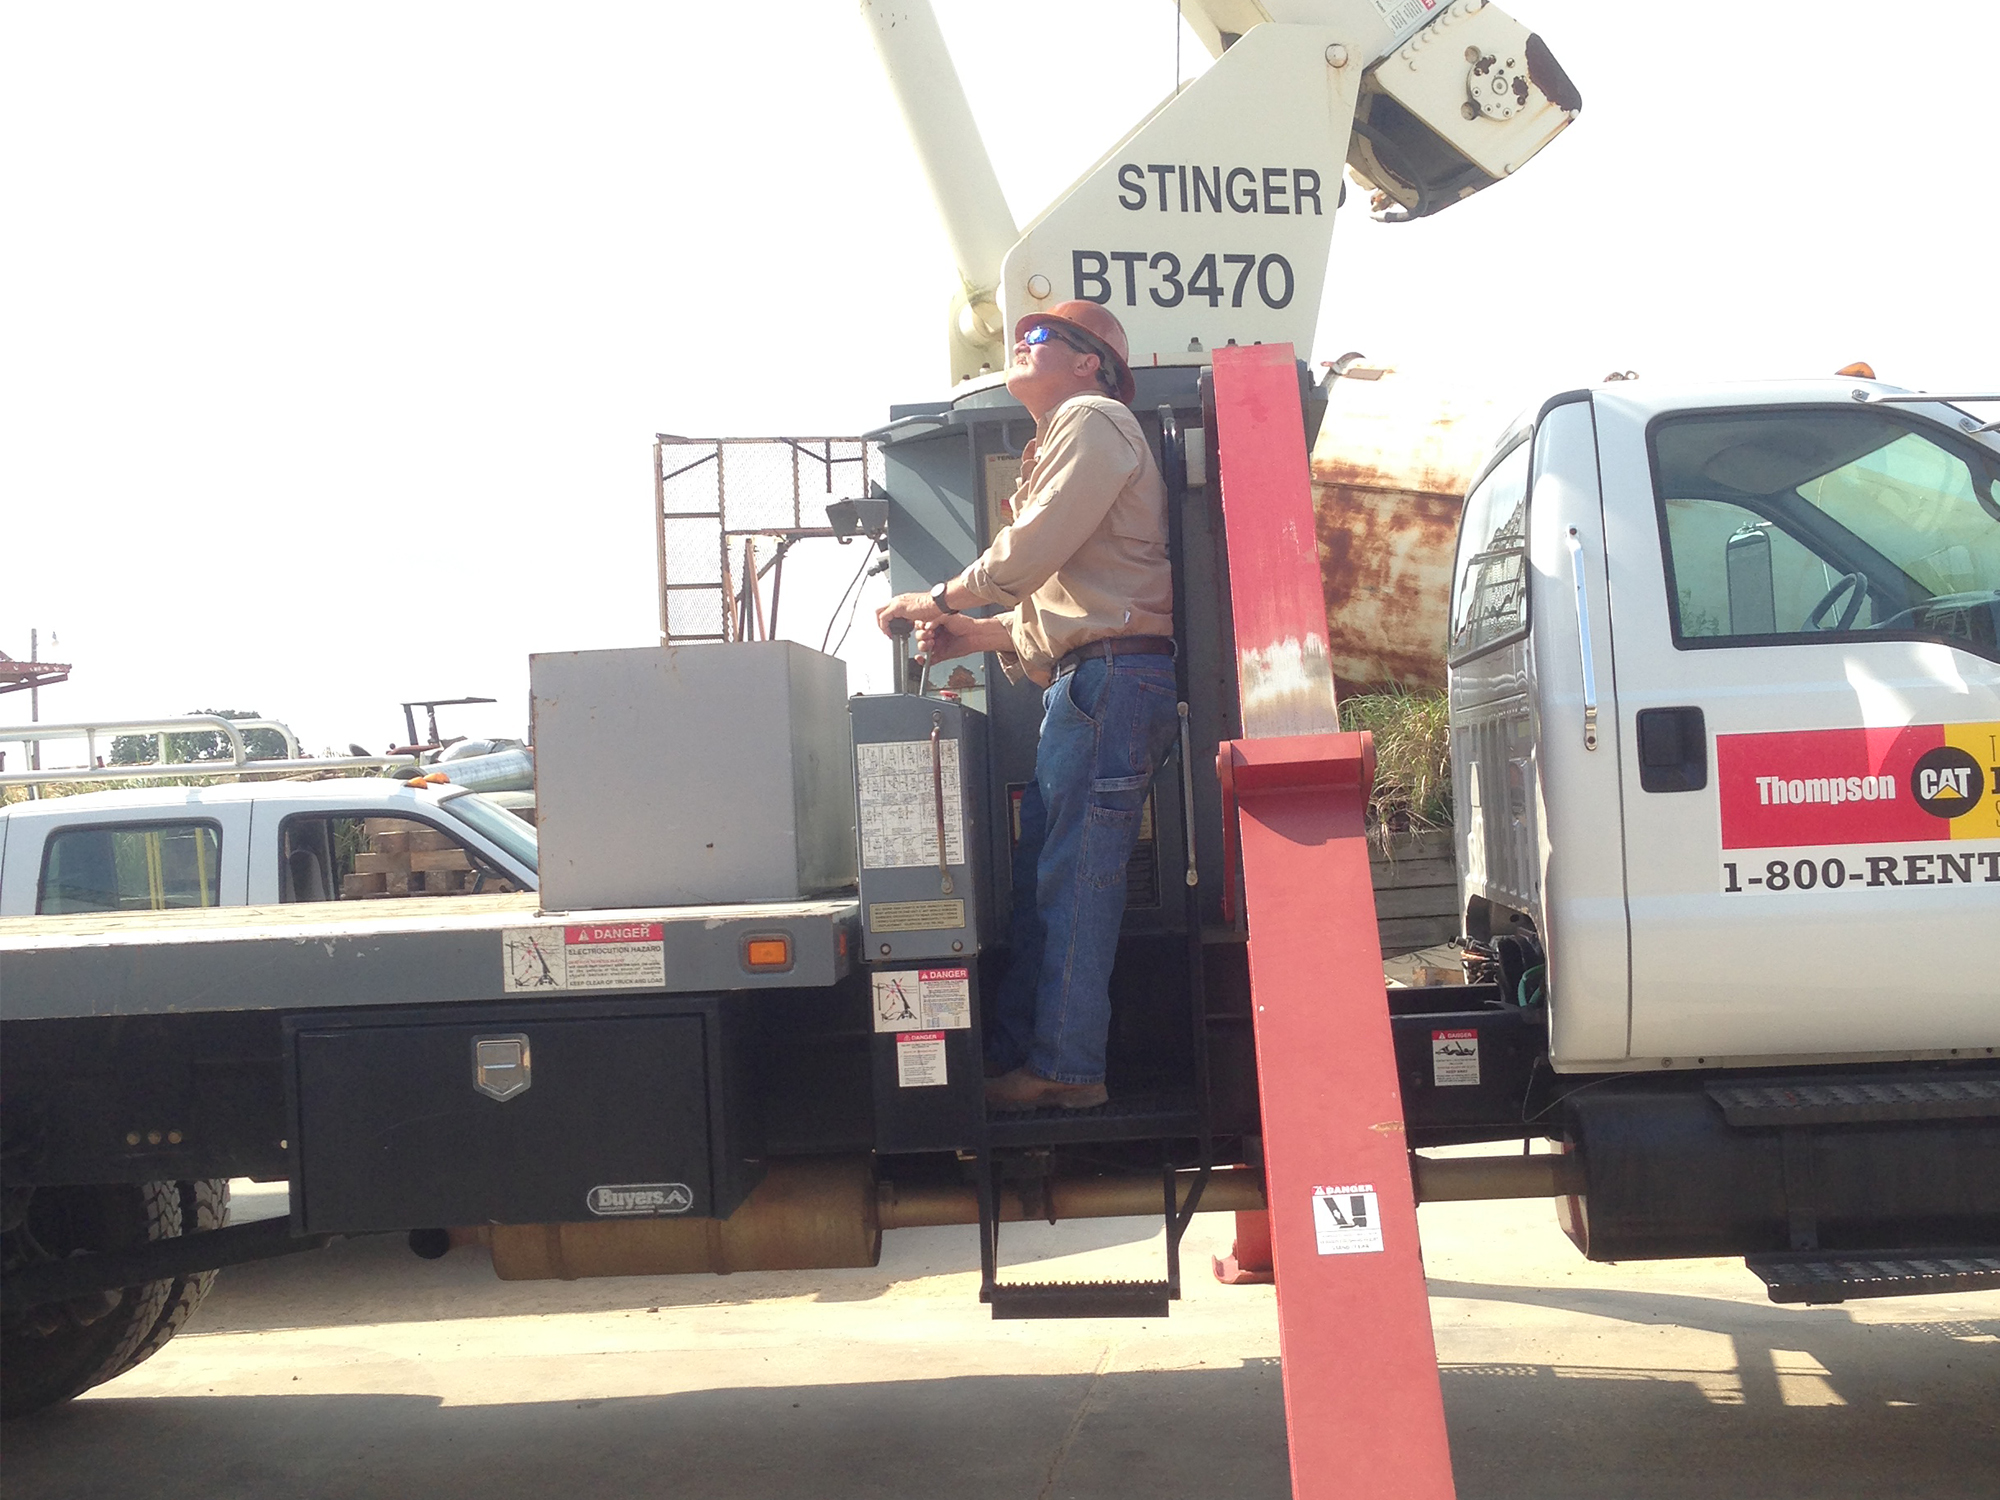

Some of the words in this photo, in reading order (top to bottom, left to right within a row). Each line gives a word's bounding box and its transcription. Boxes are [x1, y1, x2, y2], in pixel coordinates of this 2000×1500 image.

[1118, 163, 1322, 215] STINGER
[1072, 250, 1294, 309] BT3470
[1756, 774, 1896, 806] Thompson
[1919, 767, 1971, 800] CAT
[1724, 852, 2000, 893] 1-800-RENT
[594, 927, 650, 939] DANGER
[568, 947, 629, 955] ELECTROCUTION
[631, 945, 662, 953] HAZARD
[930, 970, 967, 979] DANGER
[598, 1188, 664, 1209] Buyers
[1326, 1184, 1374, 1195] DANGER
